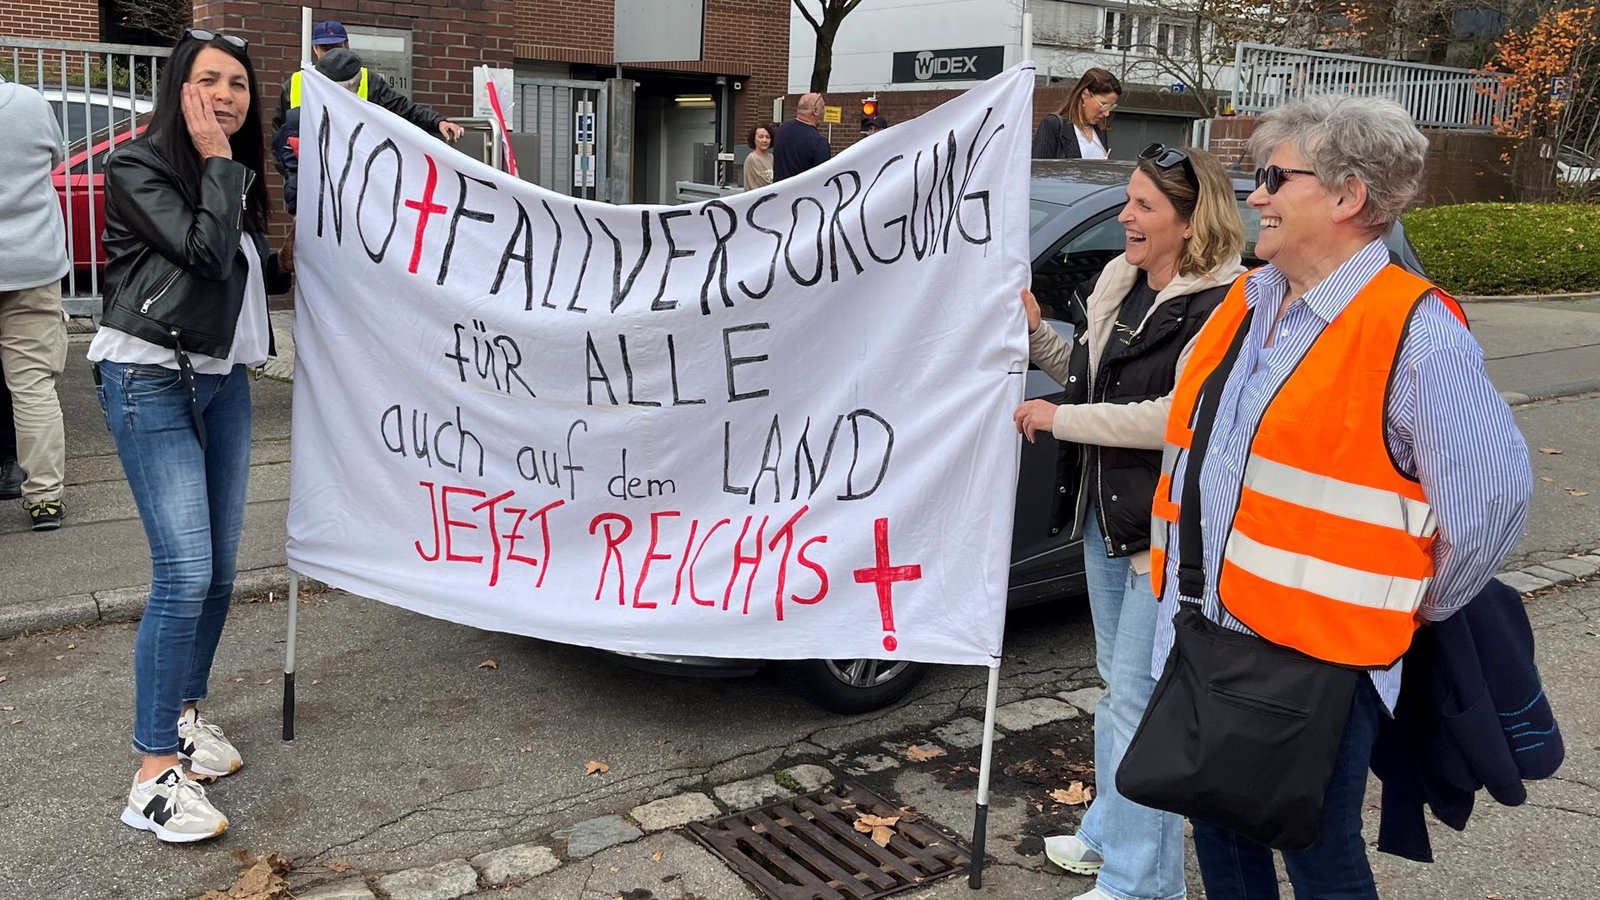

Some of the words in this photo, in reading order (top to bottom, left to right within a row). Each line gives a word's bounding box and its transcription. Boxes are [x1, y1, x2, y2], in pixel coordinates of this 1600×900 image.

[914, 51, 978, 80] WIDEX
[586, 322, 770, 407] ALLE
[380, 403, 485, 478] auch
[516, 418, 588, 501] auf
[607, 448, 677, 501] dem
[723, 408, 895, 505] LAND
[414, 480, 565, 588] JETZT
[588, 504, 829, 622] REICHTS
